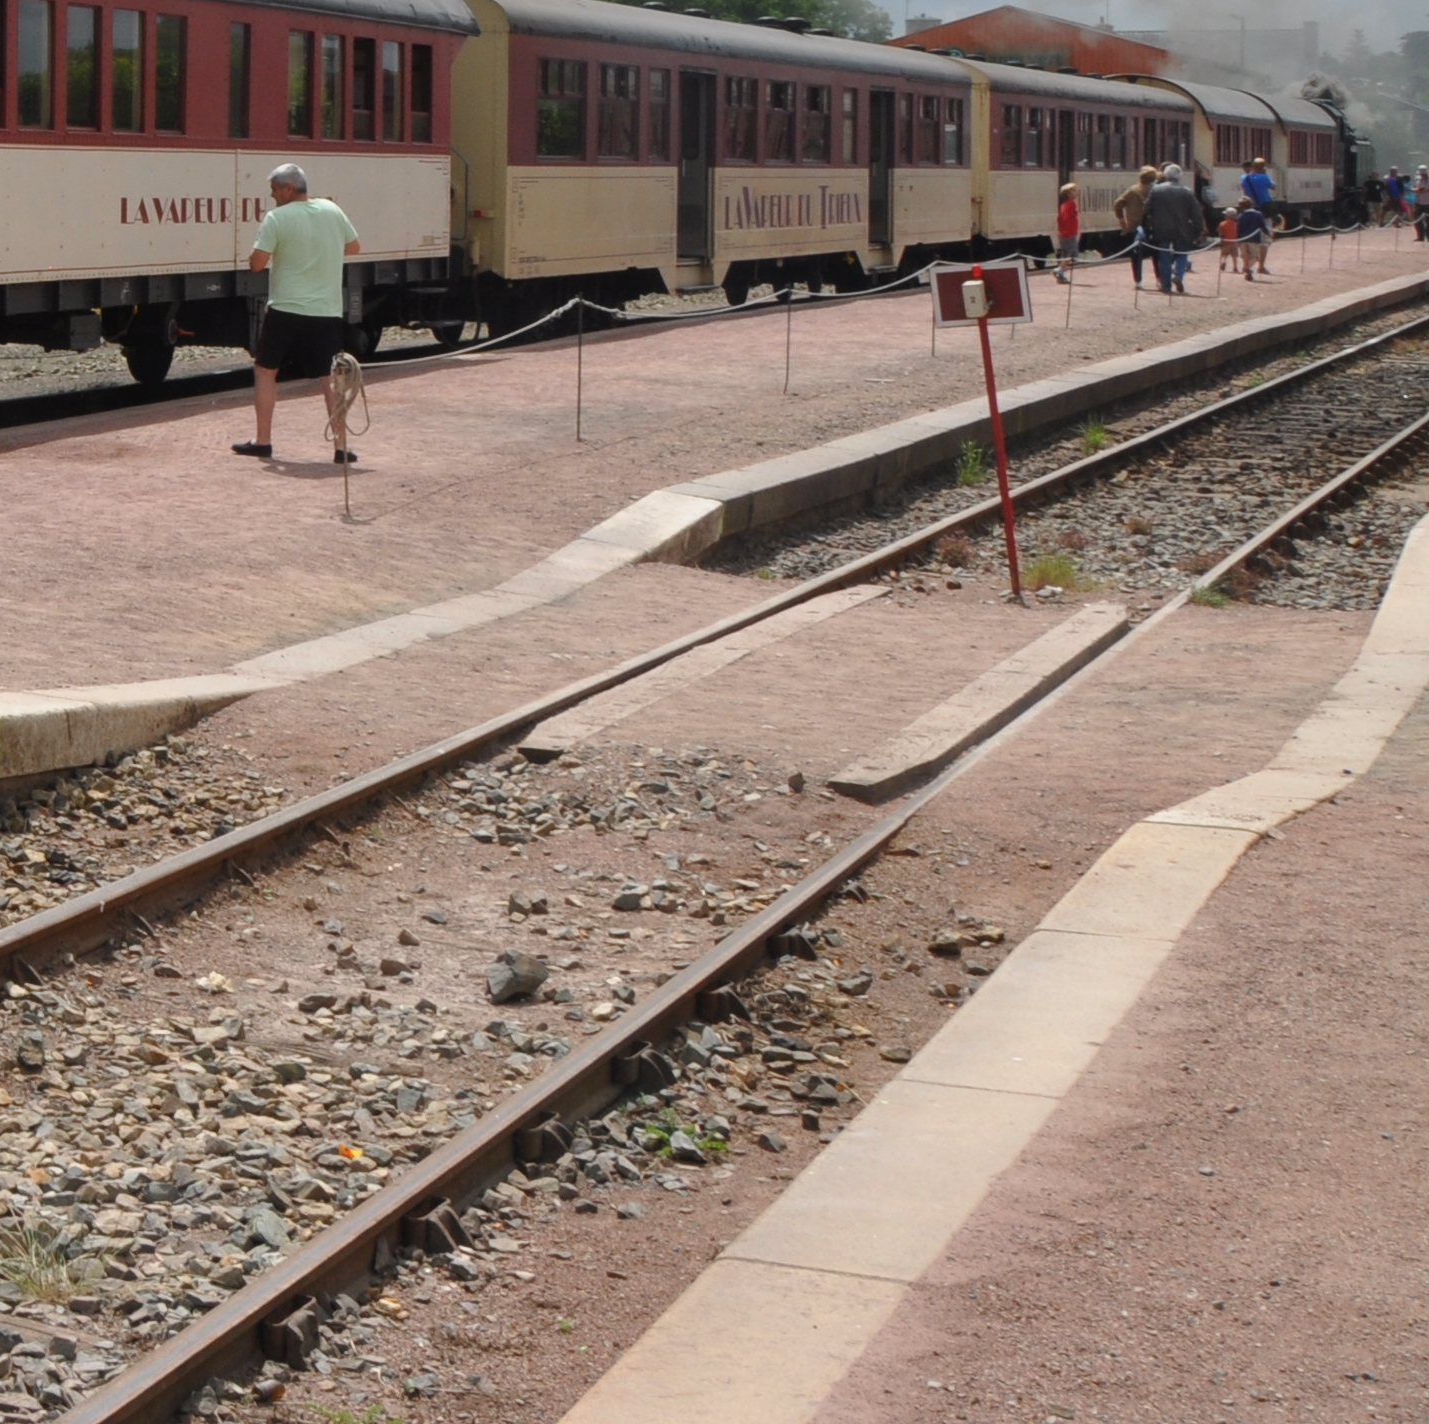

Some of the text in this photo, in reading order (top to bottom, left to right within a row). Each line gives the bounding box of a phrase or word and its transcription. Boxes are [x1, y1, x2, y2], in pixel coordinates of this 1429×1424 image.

[120, 197, 150, 225] LA
[152, 197, 232, 225] VAPEUR
[970, 296, 976, 304] 2
